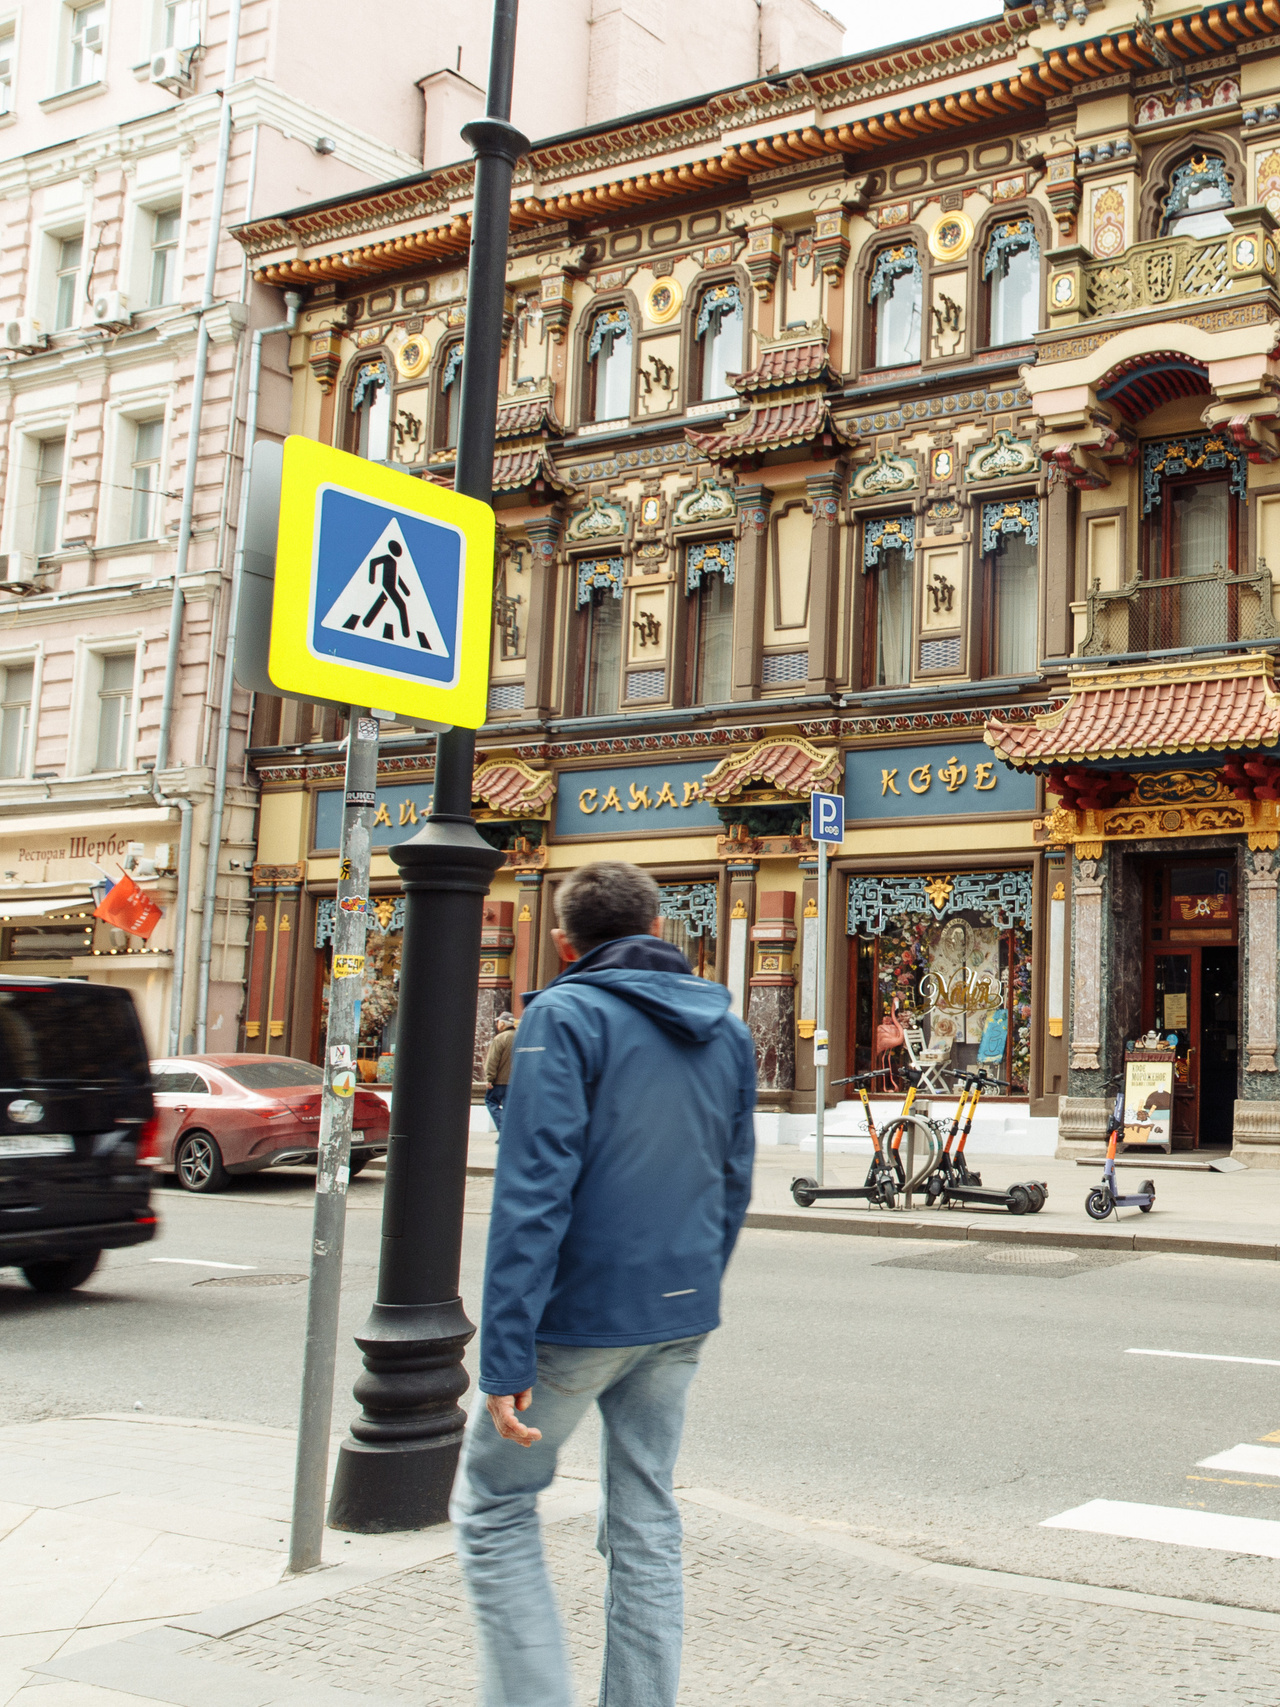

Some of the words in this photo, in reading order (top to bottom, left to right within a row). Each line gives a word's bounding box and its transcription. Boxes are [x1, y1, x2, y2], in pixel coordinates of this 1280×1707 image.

[881, 756, 998, 796] КОФЕ
[372, 798, 419, 827] АЙ
[18, 848, 67, 864] Ресторан
